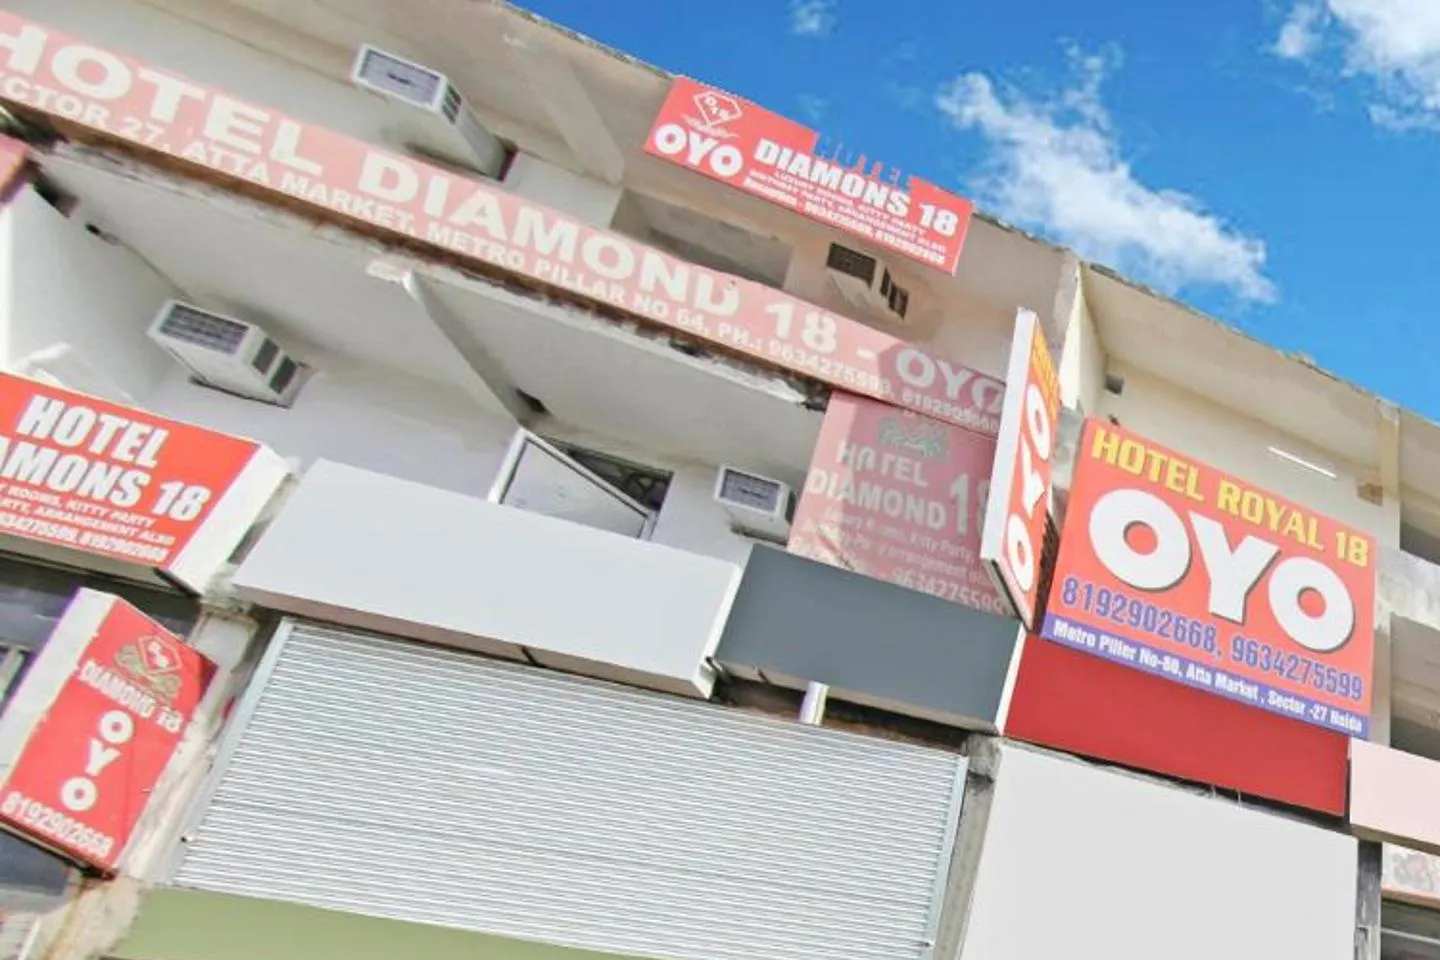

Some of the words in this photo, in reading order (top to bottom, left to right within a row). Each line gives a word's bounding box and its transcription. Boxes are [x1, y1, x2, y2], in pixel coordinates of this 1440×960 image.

[654, 123, 744, 178] OYO
[754, 137, 911, 218] DIAMONS
[918, 202, 960, 238] 18
[0, 73, 110, 128] CTOR
[187, 141, 272, 187] ATTA
[279, 174, 415, 234] MARKET,
[427, 220, 526, 268] METRO
[534, 259, 626, 302] PILLAR
[633, 293, 669, 319] NO
[0, 25, 323, 176] HOTEL
[357, 151, 739, 317] DIAMOND
[765, 301, 838, 354] 18
[896, 346, 1005, 415] OYO
[15, 394, 170, 469] HOTEL
[836, 439, 929, 489] HOTEL
[152, 480, 213, 522] 18
[805, 467, 947, 531] DIAMOND
[1006, 382, 1052, 592] OYO
[1091, 427, 1206, 503] HOTEL
[1216, 478, 1325, 552] ROYAL
[1335, 531, 1369, 568] 18
[1088, 487, 1357, 653] OYO
[1052, 619, 1097, 648] Metro
[60, 709, 135, 813] OYO
[156, 705, 184, 734] 18
